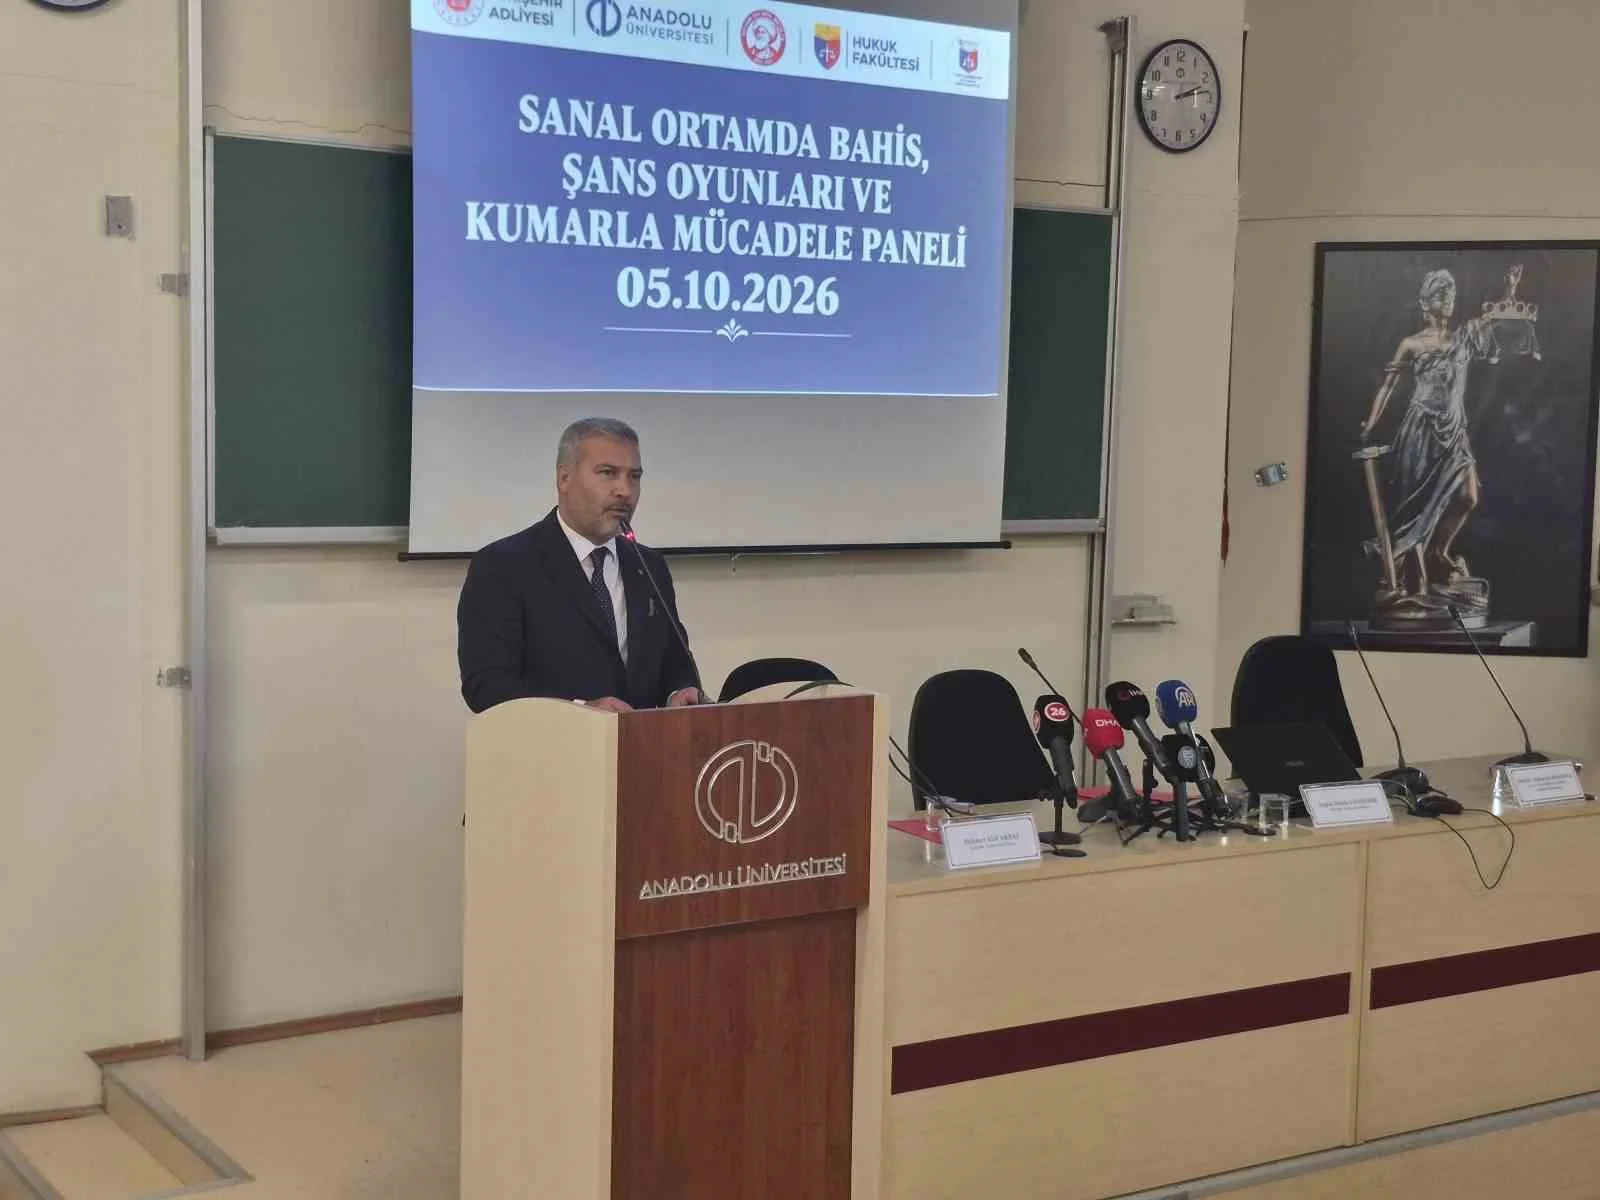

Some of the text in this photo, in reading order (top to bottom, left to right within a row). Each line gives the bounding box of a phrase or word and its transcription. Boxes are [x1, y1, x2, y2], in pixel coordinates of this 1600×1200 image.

[489, 6, 553, 26] ADLİYESİ
[626, 5, 713, 29] ANADOLU
[626, 23, 714, 45] ÜNİVERSİTESİ
[852, 36, 897, 52] HUKUK
[852, 54, 920, 72] FAKÜLTESİ
[518, 94, 929, 175] SANAL ORTAMDA BAHİS,
[562, 152, 892, 214] ŞANS OYUNLARI VE
[465, 201, 968, 268] KUMARLA MÜCADELE PANELİ
[616, 266, 840, 316] 05.10.2026
[1050, 707, 1066, 716] 26
[640, 852, 847, 898] ANADOLU ÜNİVERSİTESİ
